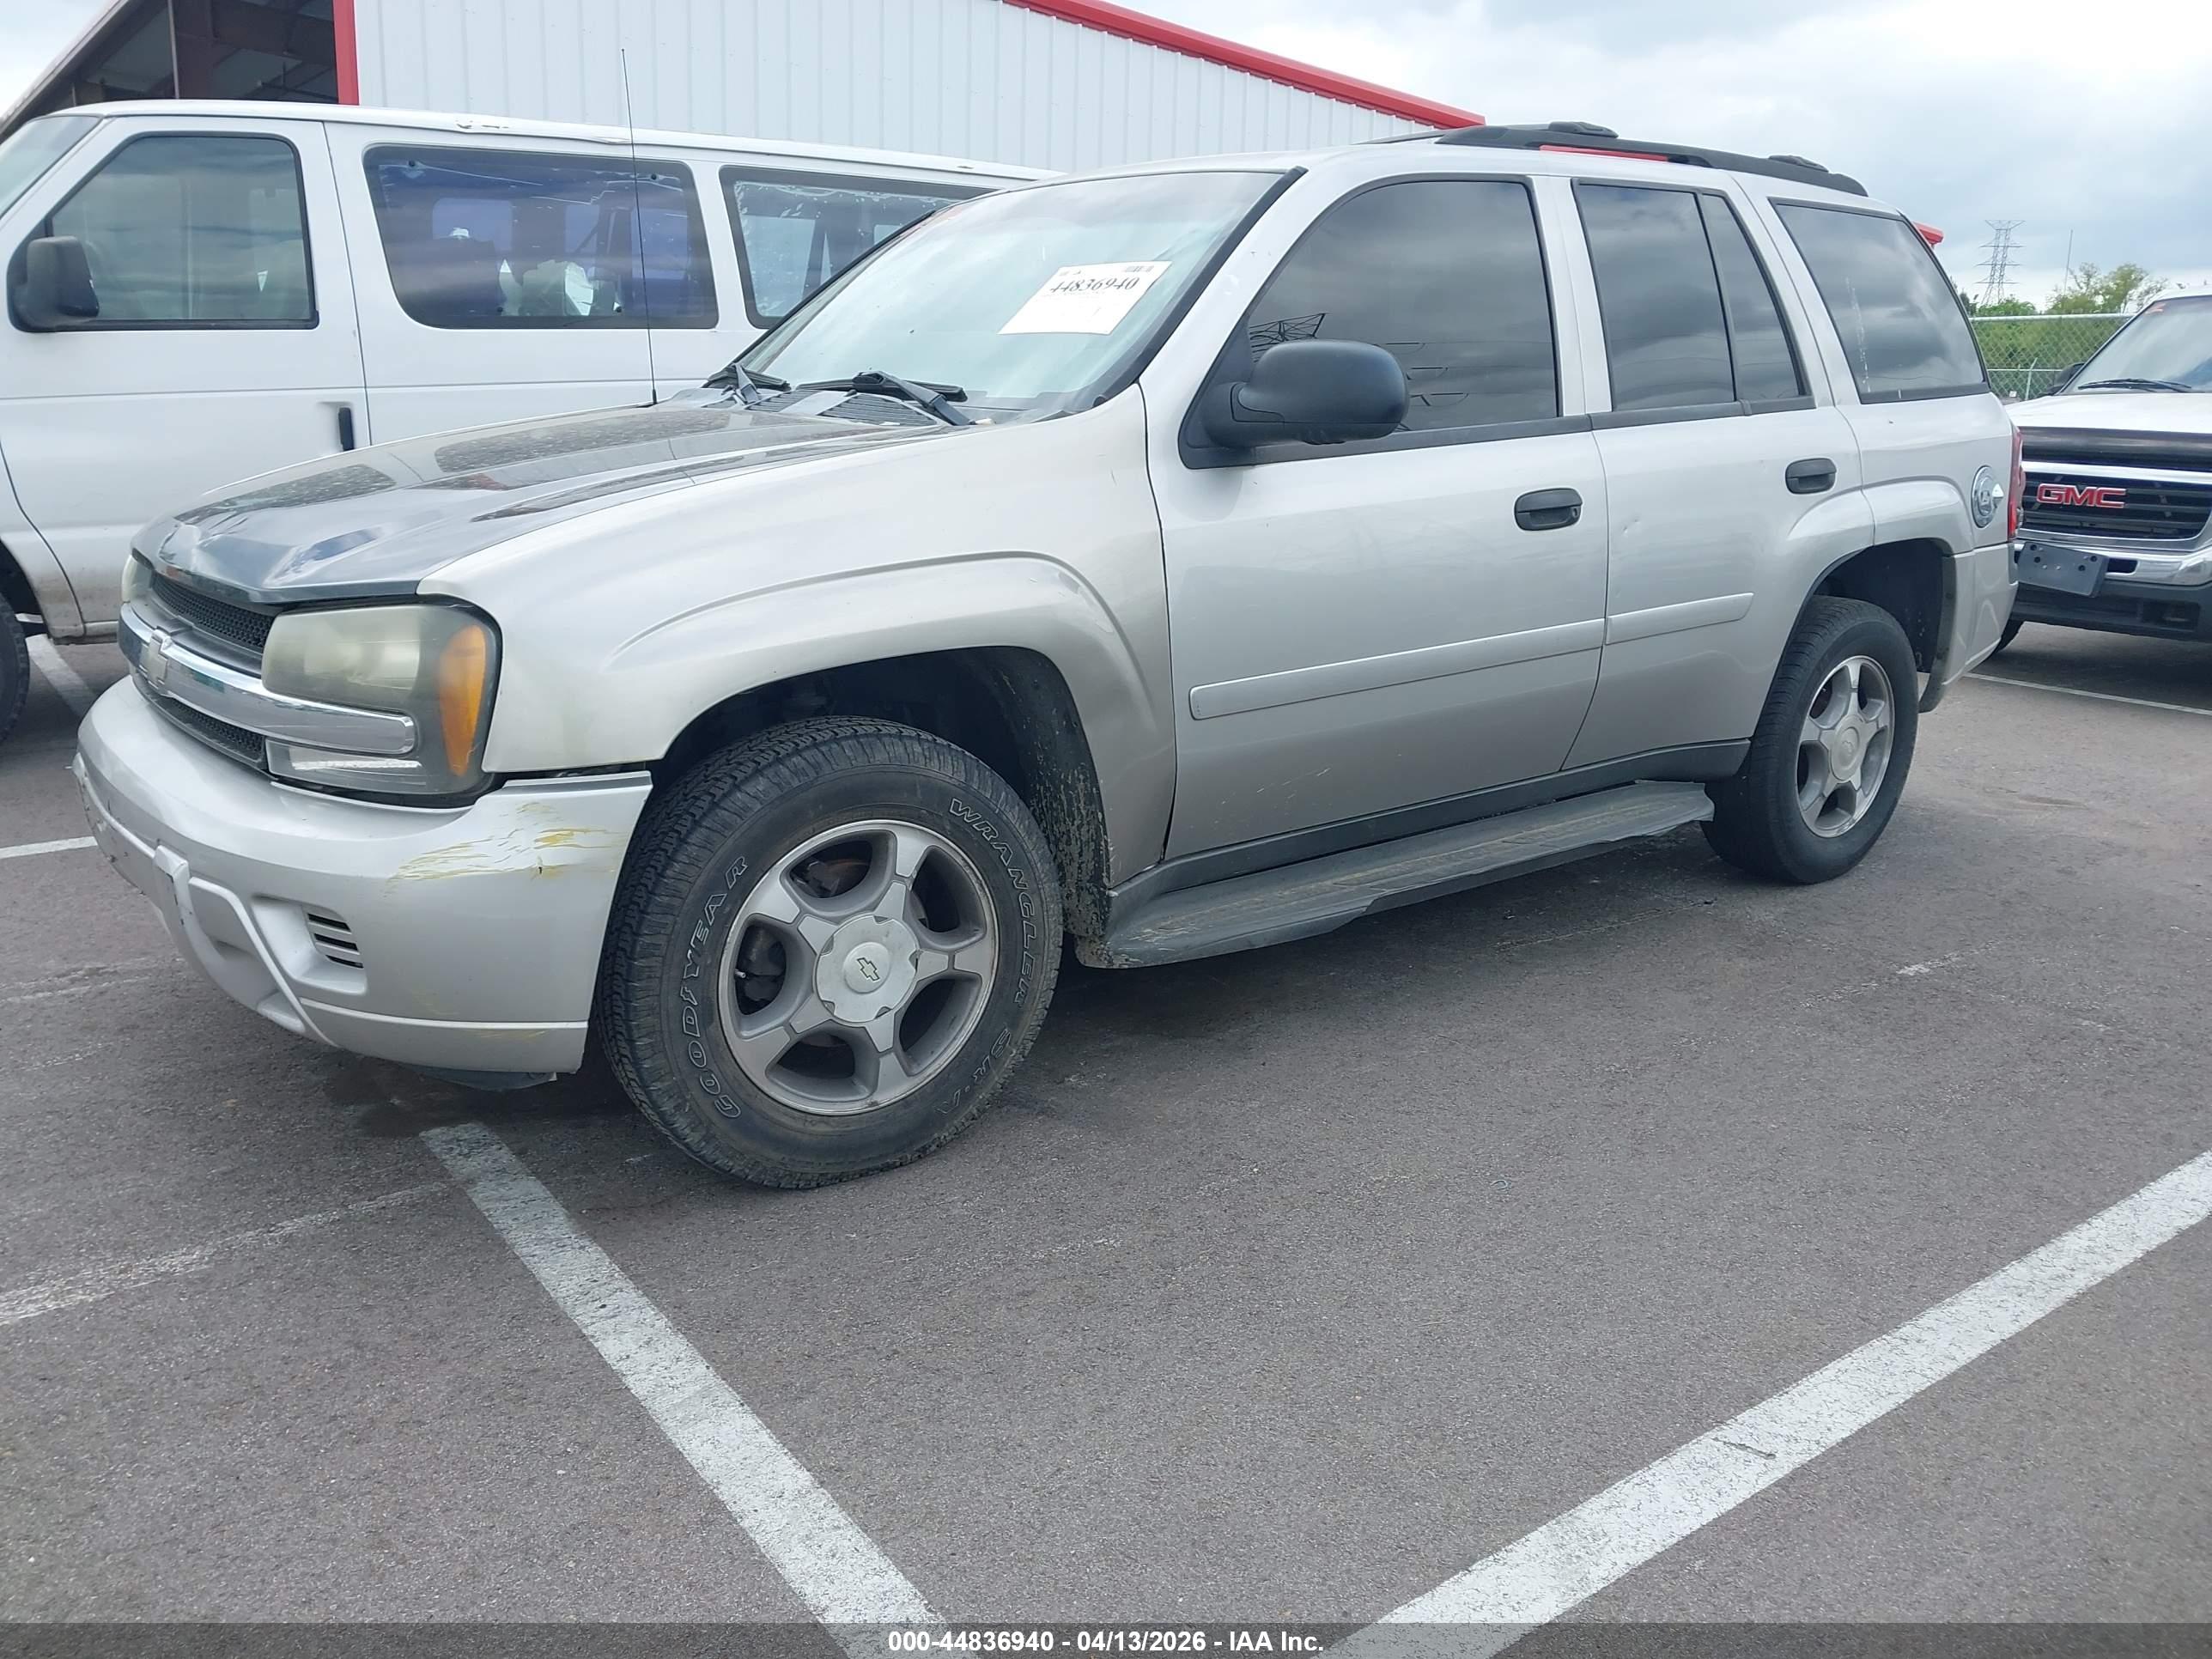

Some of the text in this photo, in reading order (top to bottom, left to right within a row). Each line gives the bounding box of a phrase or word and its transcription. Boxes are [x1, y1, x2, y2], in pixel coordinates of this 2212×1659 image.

[1050, 276, 1140, 293] 44836940
[2036, 483, 2127, 508] GMC
[949, 798, 1037, 1004] WRANGLER
[680, 856, 748, 1118] GOODYEAR
